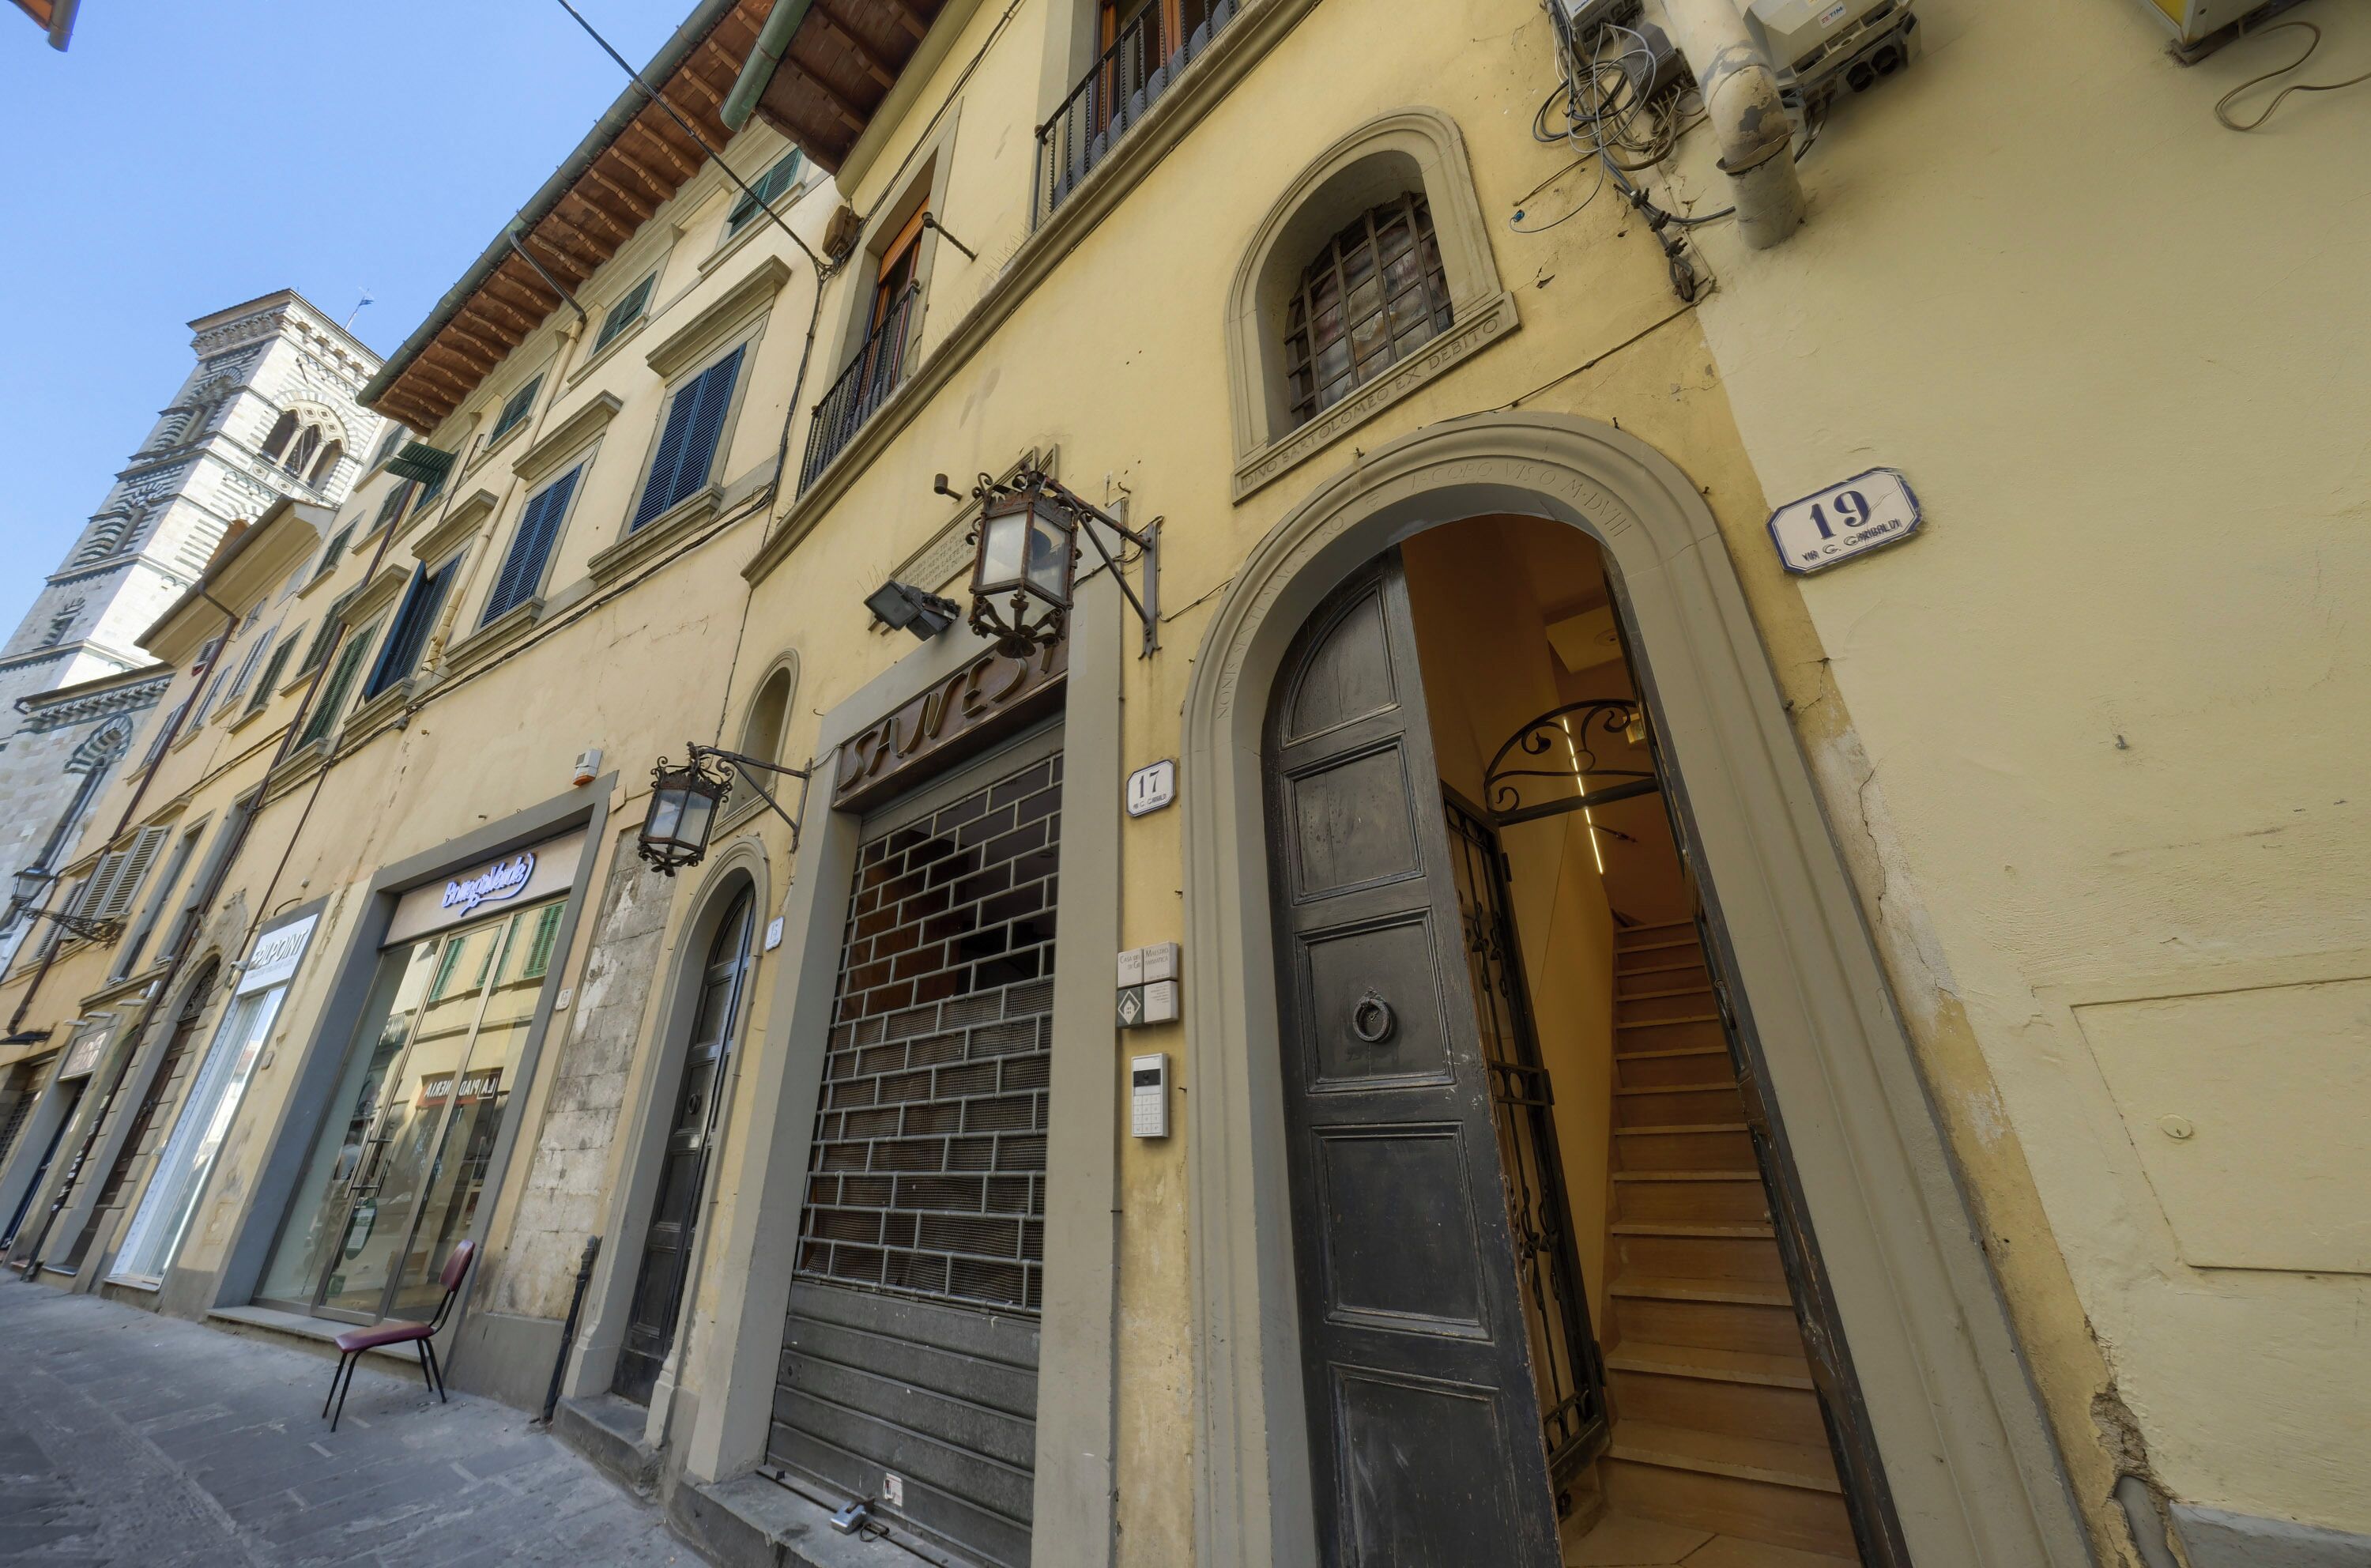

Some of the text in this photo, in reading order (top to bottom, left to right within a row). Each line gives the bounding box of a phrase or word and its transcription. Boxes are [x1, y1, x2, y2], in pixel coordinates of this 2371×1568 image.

[1829, 6, 1843, 17] TIM
[1242, 318, 1498, 488] DIVO BARTOLOMEO EX DEBITO
[1810, 490, 1872, 540] 19
[1802, 549, 1820, 562] VIA
[1843, 517, 1902, 547] GARIBALDI
[1138, 769, 1160, 799] 17
